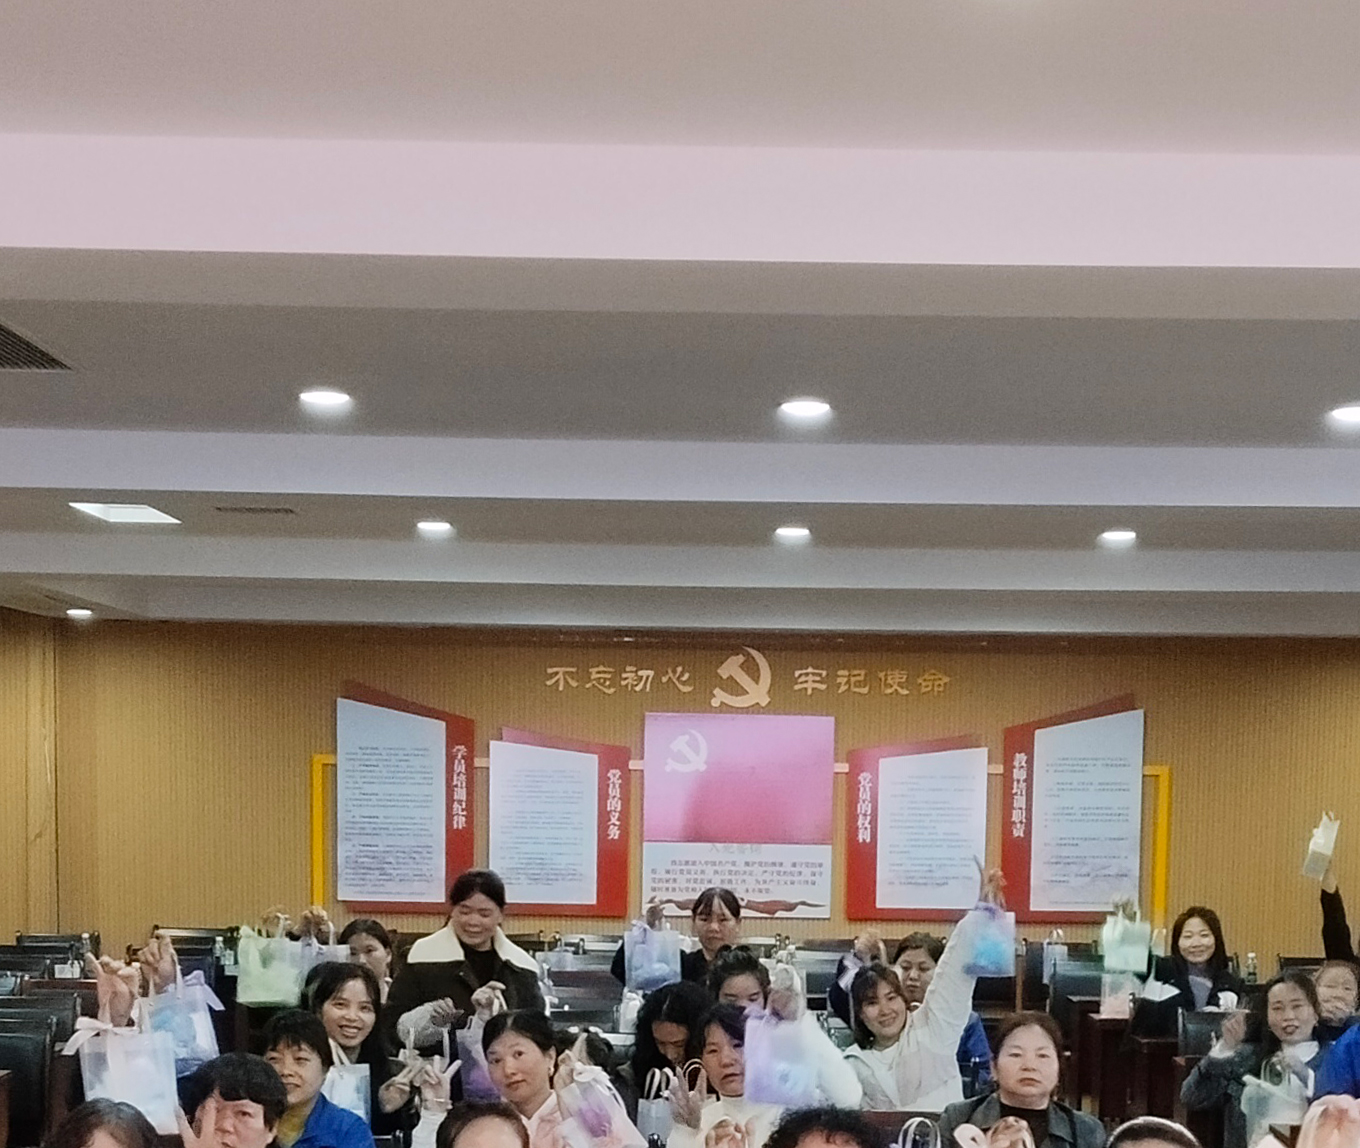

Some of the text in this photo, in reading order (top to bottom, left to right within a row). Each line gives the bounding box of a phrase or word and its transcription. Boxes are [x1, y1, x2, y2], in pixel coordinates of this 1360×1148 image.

[545, 665, 950, 696] 不忘初心 牢记使命
[606, 768, 622, 840] 党员的义务
[857, 772, 872, 843] 党员的权利
